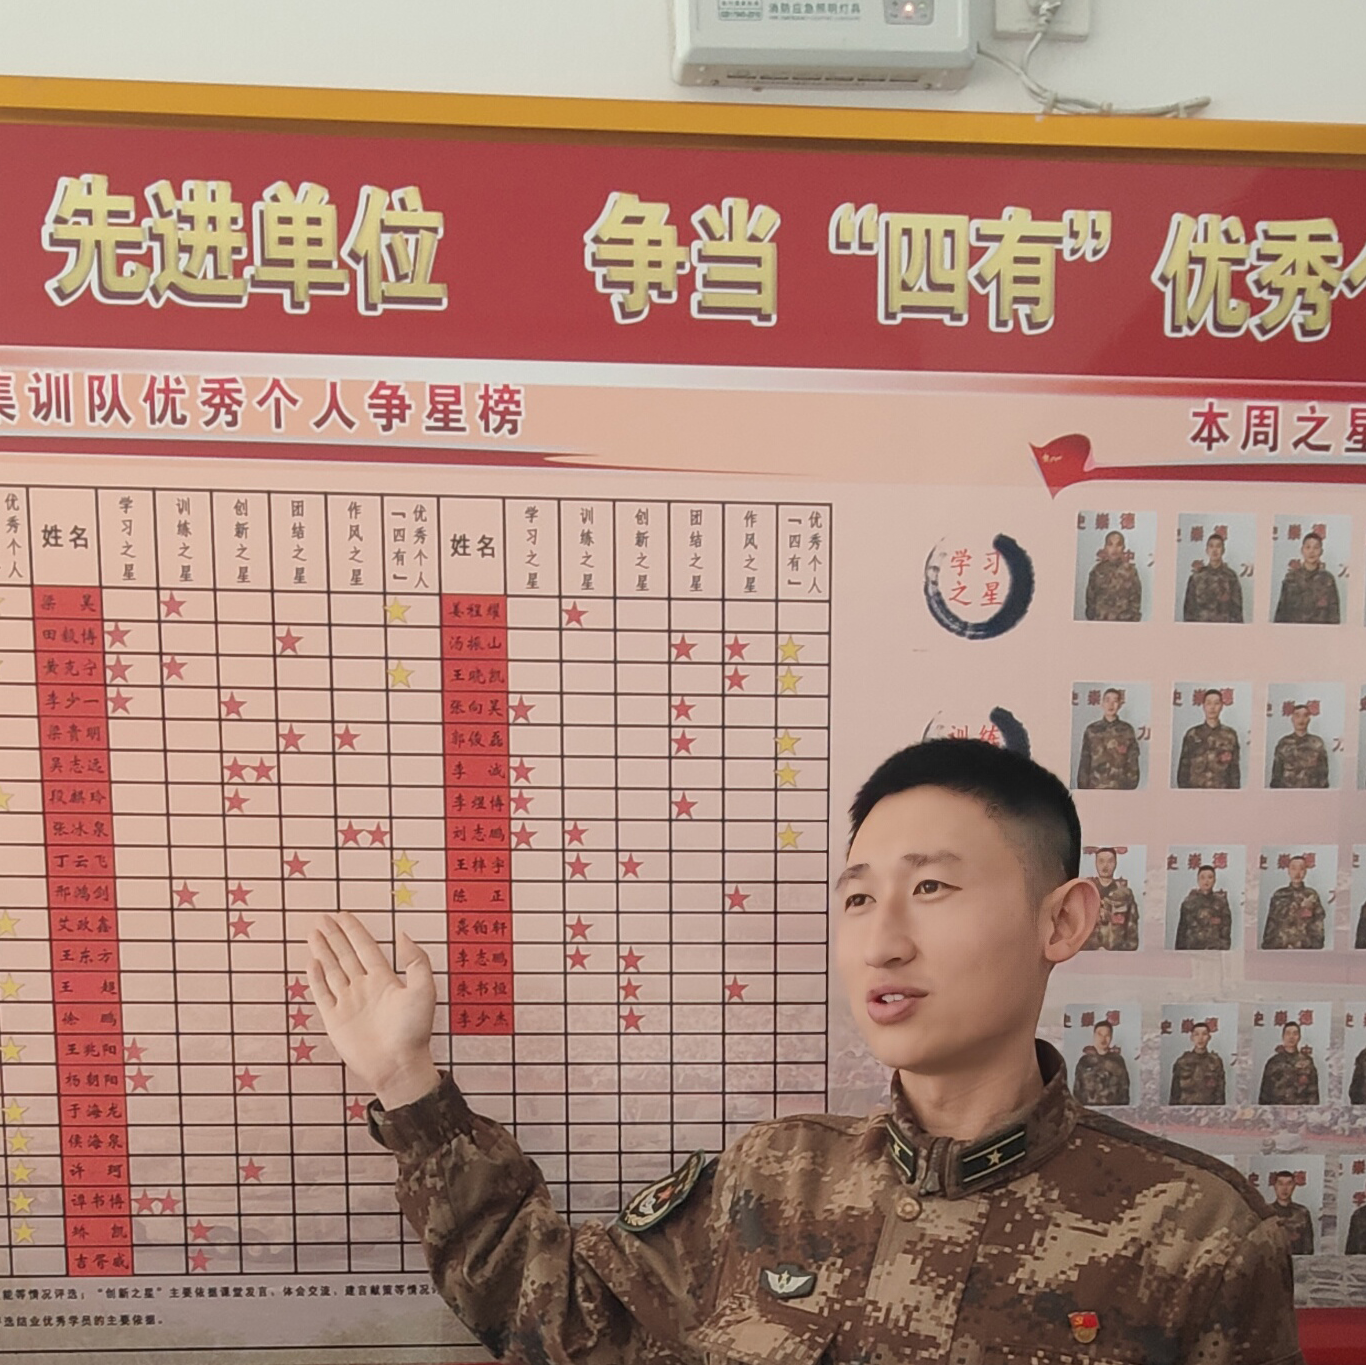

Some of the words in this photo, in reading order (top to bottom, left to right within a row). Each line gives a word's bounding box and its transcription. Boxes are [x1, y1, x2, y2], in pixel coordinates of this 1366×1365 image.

[4, 492, 23, 579] 优秀个人
[40, 523, 91, 550] 姓名
[118, 496, 136, 581] 学习之星
[176, 497, 194, 583] 训练之星
[233, 498, 251, 584] 创新之星
[290, 499, 308, 585] 团结之星
[347, 501, 365, 587] 作风之星
[412, 504, 430, 589] 优秀个人
[450, 533, 497, 559] 姓名
[524, 505, 540, 590] 学习之星
[579, 506, 595, 591] 训练之星
[634, 508, 650, 592] 创新之星
[689, 508, 704, 593] 团结之星
[743, 509, 759, 594] 作风之星
[807, 510, 823, 595] 优秀个人
[44, 689, 100, 711] 李少一
[53, 853, 109, 869] 丁云飞
[59, 946, 113, 965] 王东方
